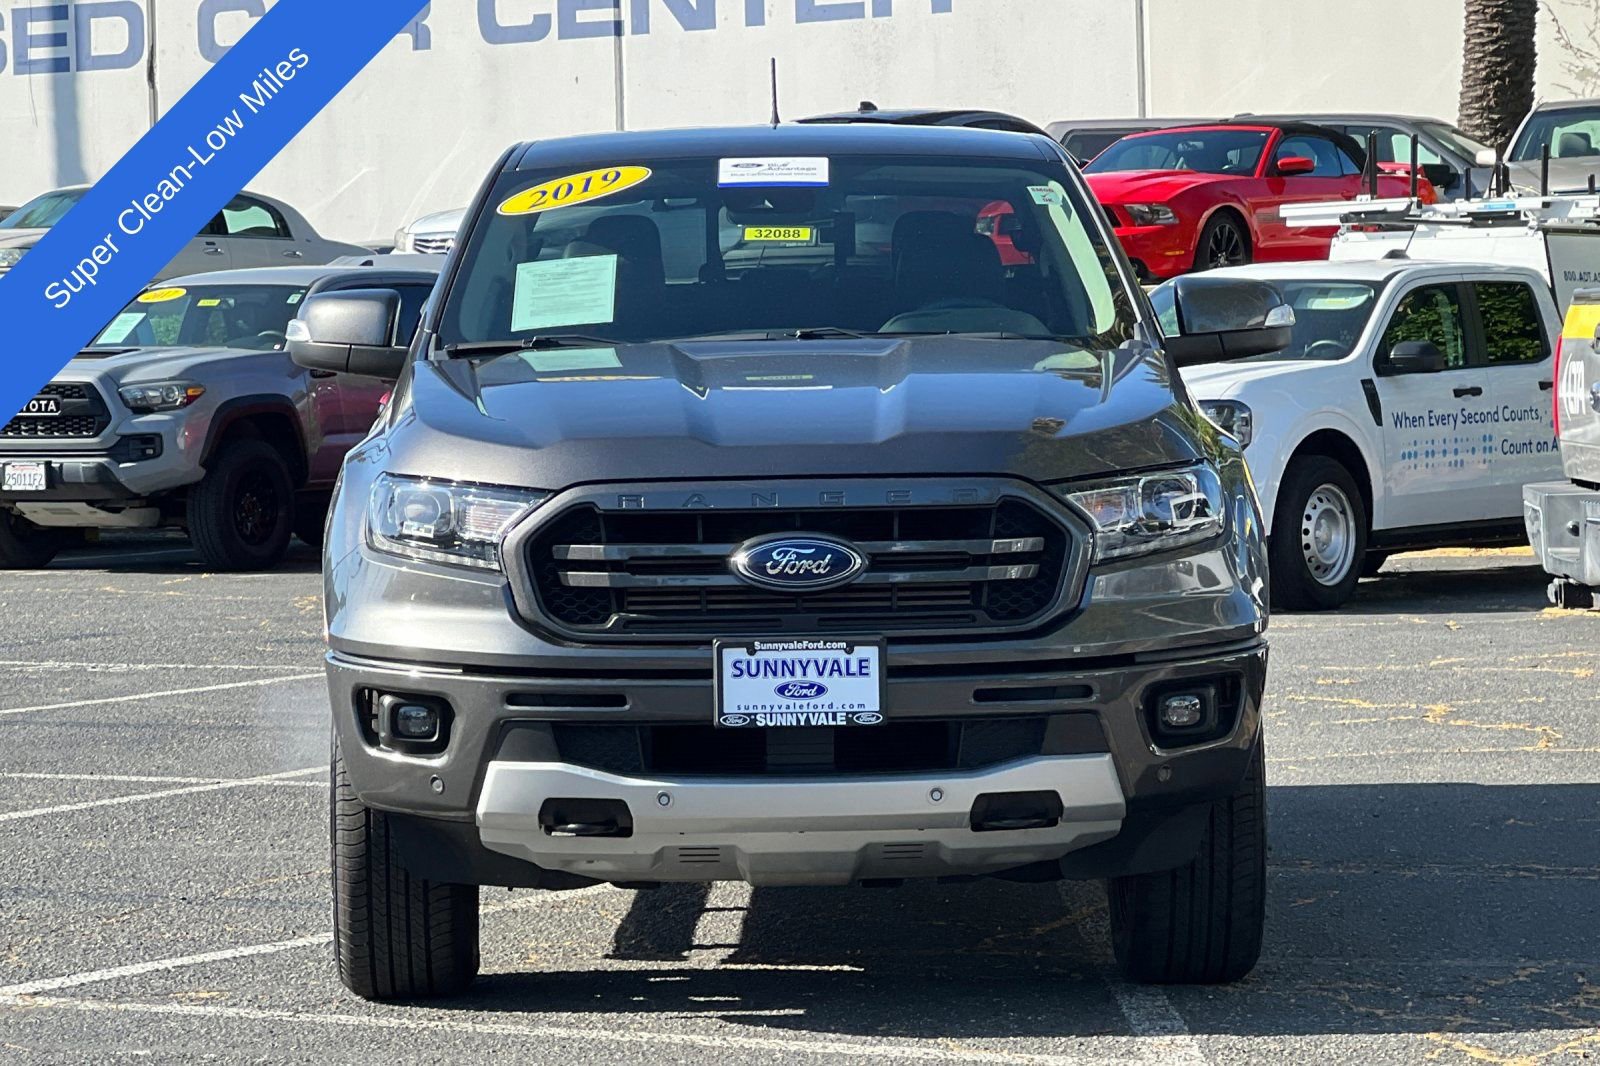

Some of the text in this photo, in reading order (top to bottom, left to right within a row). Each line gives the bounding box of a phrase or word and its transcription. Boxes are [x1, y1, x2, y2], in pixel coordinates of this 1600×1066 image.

[0, 0, 145, 76] ED
[527, 170, 621, 209] 2019
[754, 229, 801, 239] 32088
[1392, 405, 1543, 430] When Every Second Counts,
[1501, 438, 1533, 455] Count
[1536, 443, 1549, 454] on
[617, 488, 980, 509] RANGER
[765, 546, 832, 576] Ford
[754, 640, 847, 652] SunnyvaleFord.com
[731, 657, 870, 679] SUNNYVALE
[784, 682, 818, 698] Ford
[736, 701, 866, 712] sunnyvaleford.com
[756, 712, 847, 727] SUNNYVALE
